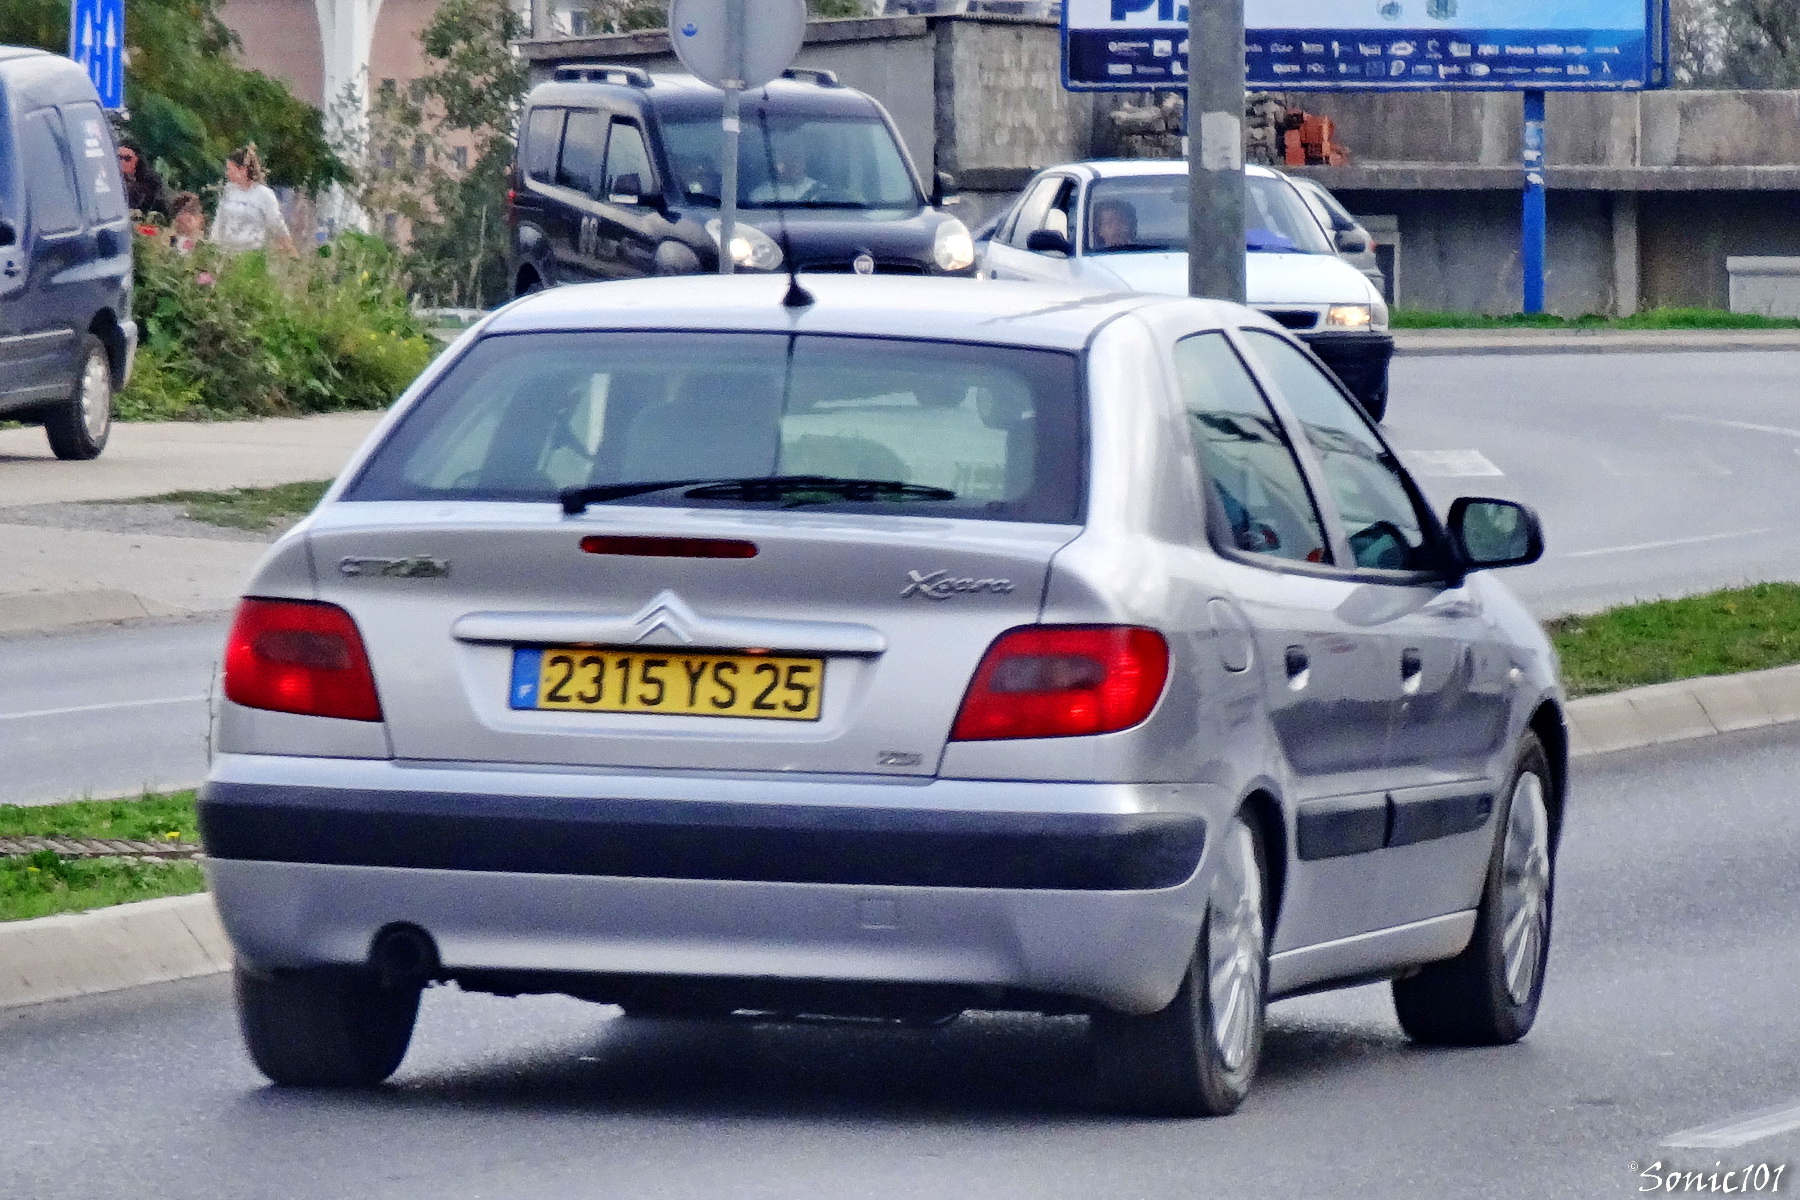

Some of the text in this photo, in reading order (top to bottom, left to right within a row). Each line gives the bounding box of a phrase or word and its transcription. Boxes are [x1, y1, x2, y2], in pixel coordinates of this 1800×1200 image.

[545, 654, 668, 707] 2315
[682, 660, 739, 709] YS
[749, 662, 815, 712] 25
